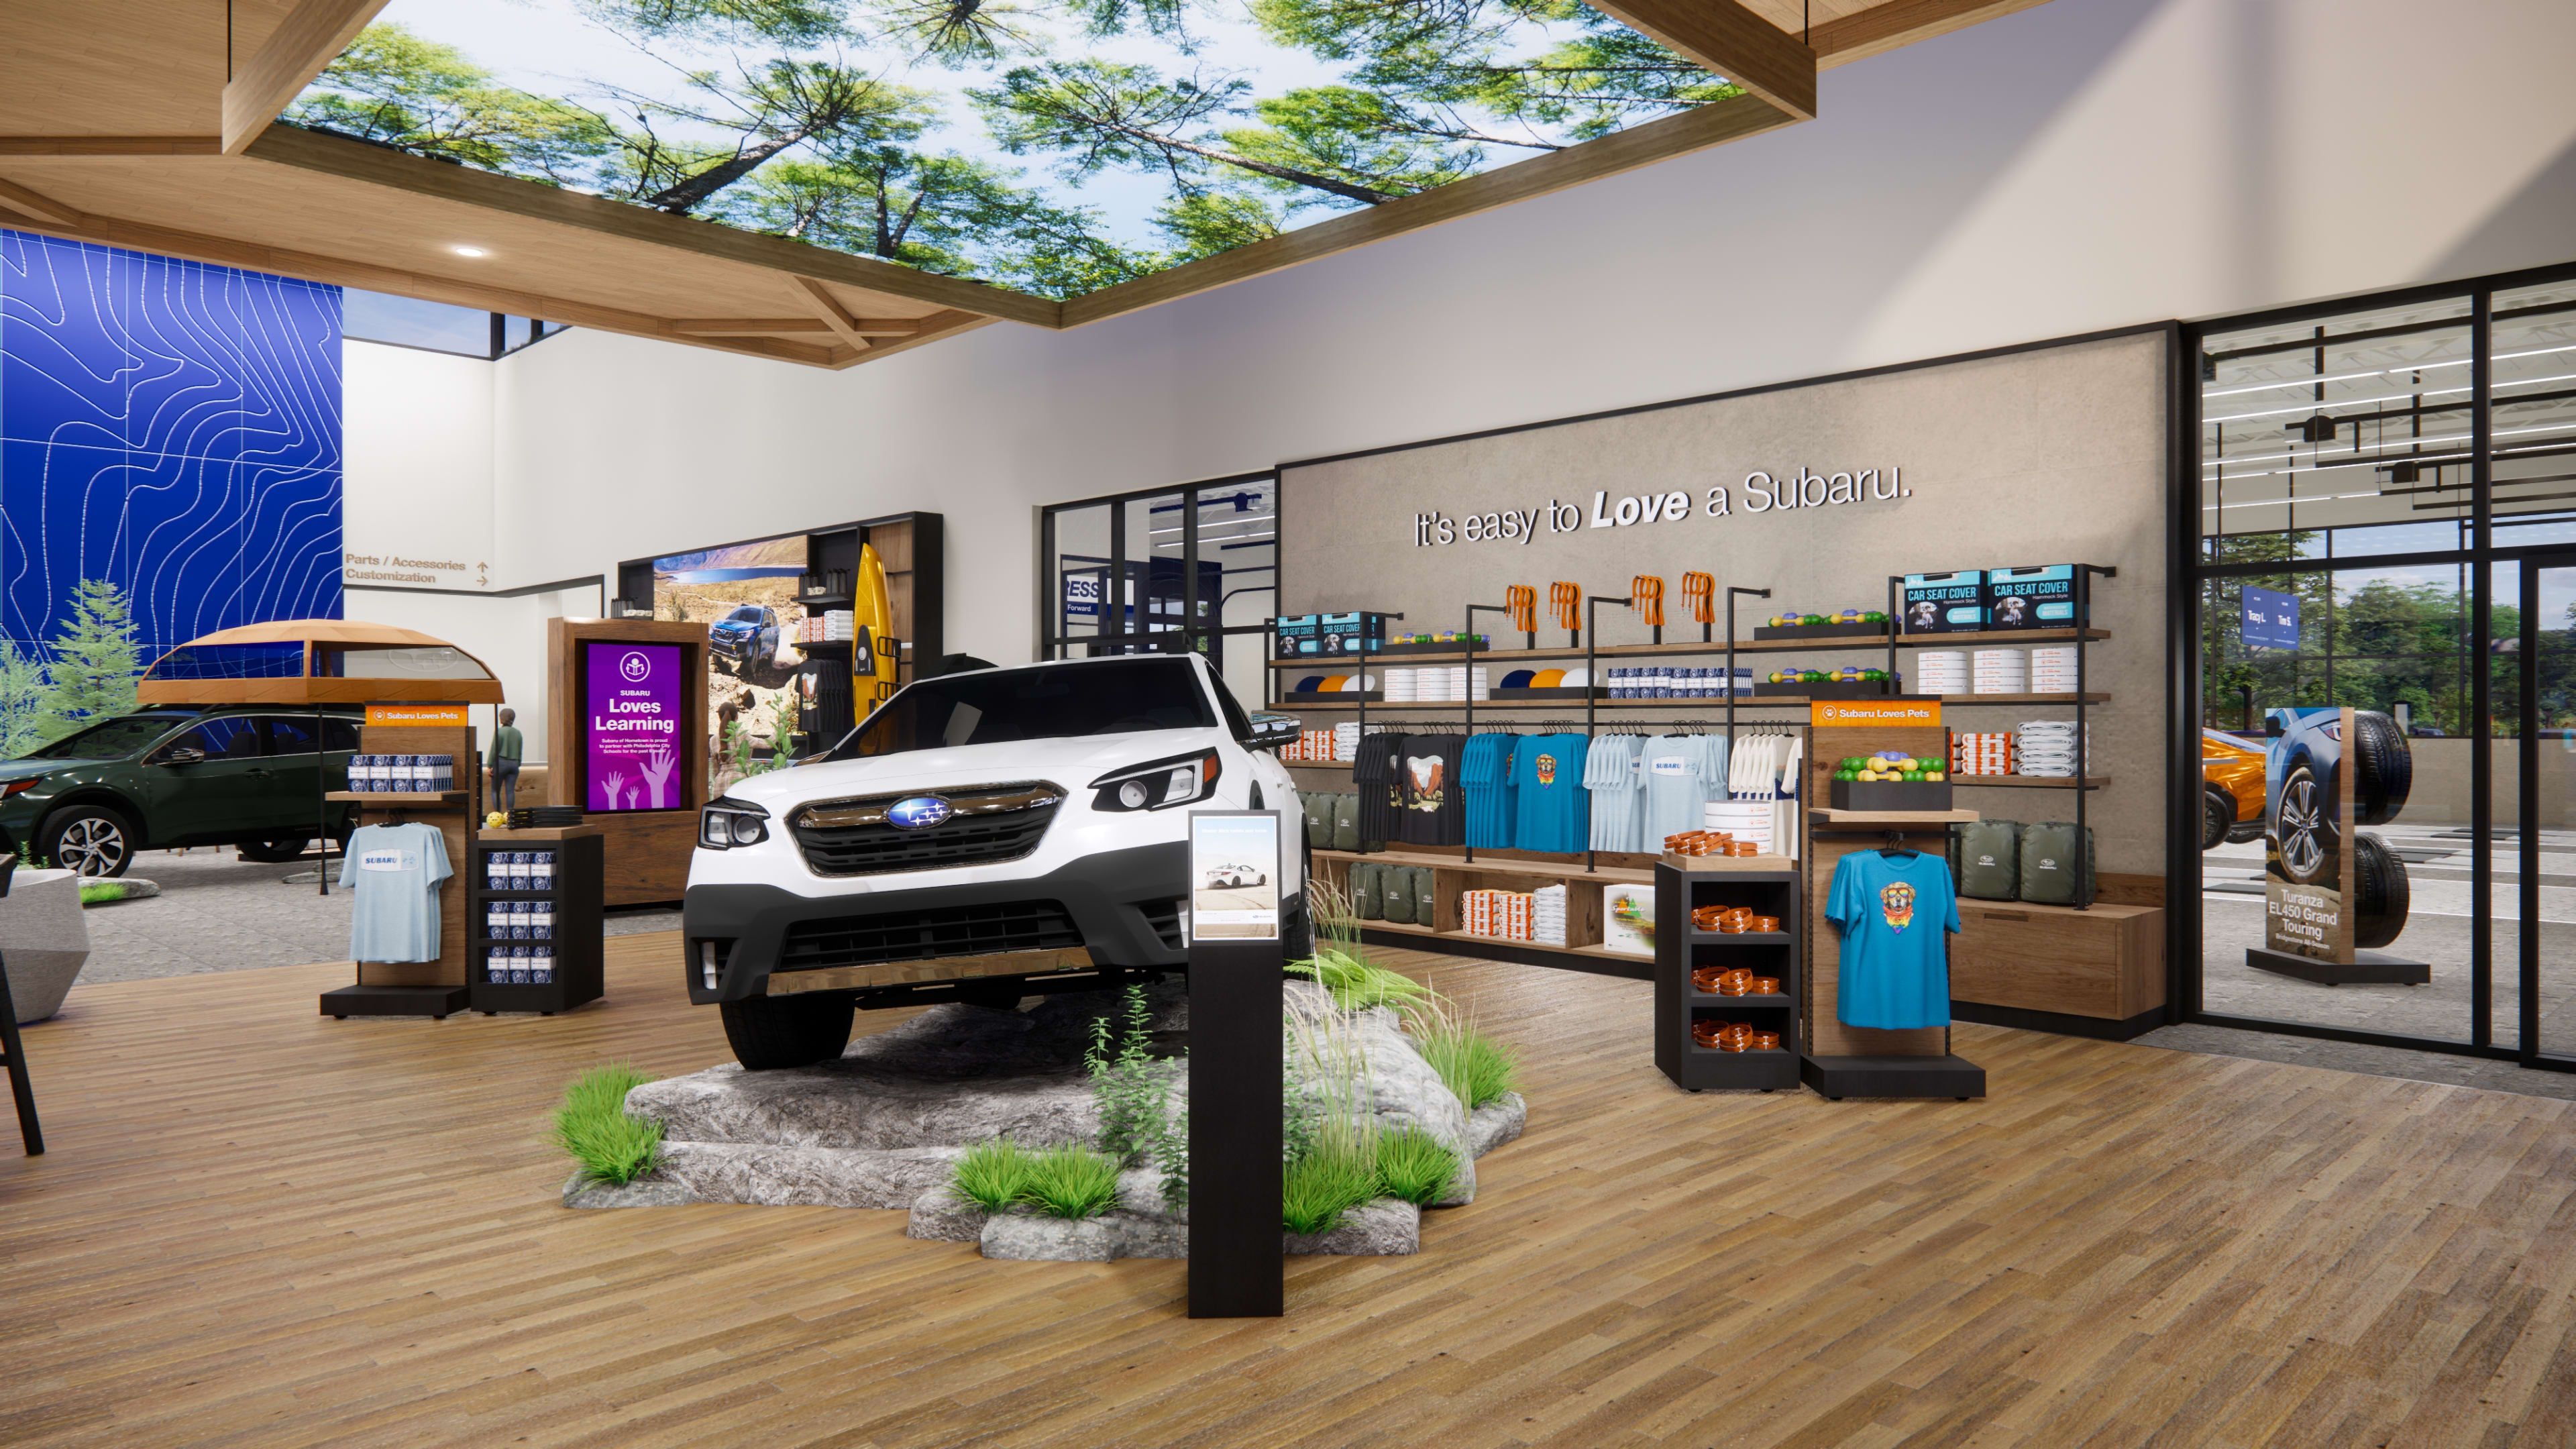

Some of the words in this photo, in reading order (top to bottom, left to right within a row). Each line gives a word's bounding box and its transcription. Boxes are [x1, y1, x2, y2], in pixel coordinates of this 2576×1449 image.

[1464, 508, 1540, 545] easy
[1547, 499, 1581, 532] to
[1591, 490, 1690, 528] Love
[1706, 486, 1731, 517] a
[1743, 467, 1911, 513] Subaru.
[345, 553, 380, 566] Parts
[383, 556, 389, 566] /
[392, 556, 466, 570] Accessories
[345, 568, 435, 583] Customization
[1067, 581, 1098, 598] ESS
[1908, 590, 1925, 601] CAR
[1927, 588, 1947, 600] SEAT
[1949, 586, 1976, 598] COVER
[1994, 585, 2012, 596] CAR
[2015, 583, 2037, 595] SEAT
[2039, 581, 2068, 594] COVER
[1067, 604, 1091, 612] Forward
[1279, 628, 1288, 636] CAR
[1289, 627, 1299, 635] SEAT
[1301, 627, 1315, 635] COVER
[1324, 625, 1333, 633] CAR
[1334, 625, 1344, 633] SEAT
[609, 698, 661, 713] Loves
[1839, 709, 1874, 718] Subaru
[1877, 709, 1905, 718] Loves
[1907, 709, 1929, 718] Pets
[596, 716, 674, 734] Learning
[2282, 889, 2324, 908] Turanza
[2269, 901, 2301, 918] EL450
[2303, 908, 2338, 926] Grand
[2282, 918, 2323, 941] Touring
